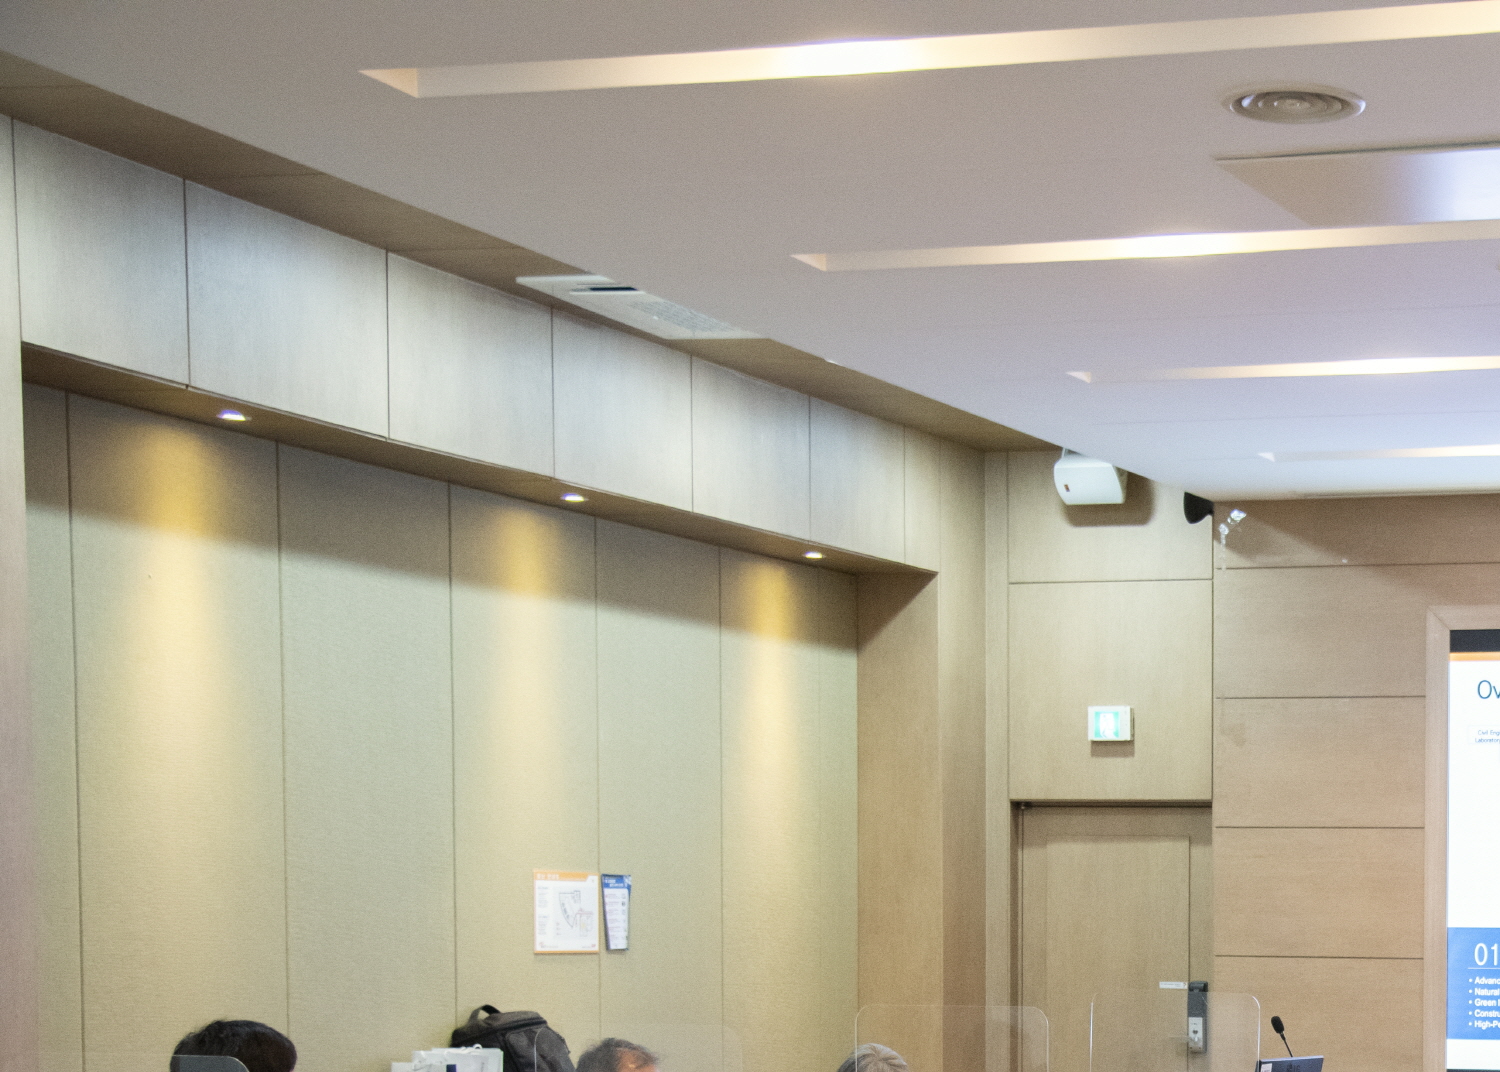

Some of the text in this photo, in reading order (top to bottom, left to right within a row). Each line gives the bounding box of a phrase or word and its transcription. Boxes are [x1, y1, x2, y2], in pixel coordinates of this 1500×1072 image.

[1474, 942, 1498, 966] 01
[1474, 987, 1500, 996] Natural
[1474, 998, 1497, 1007] Green
